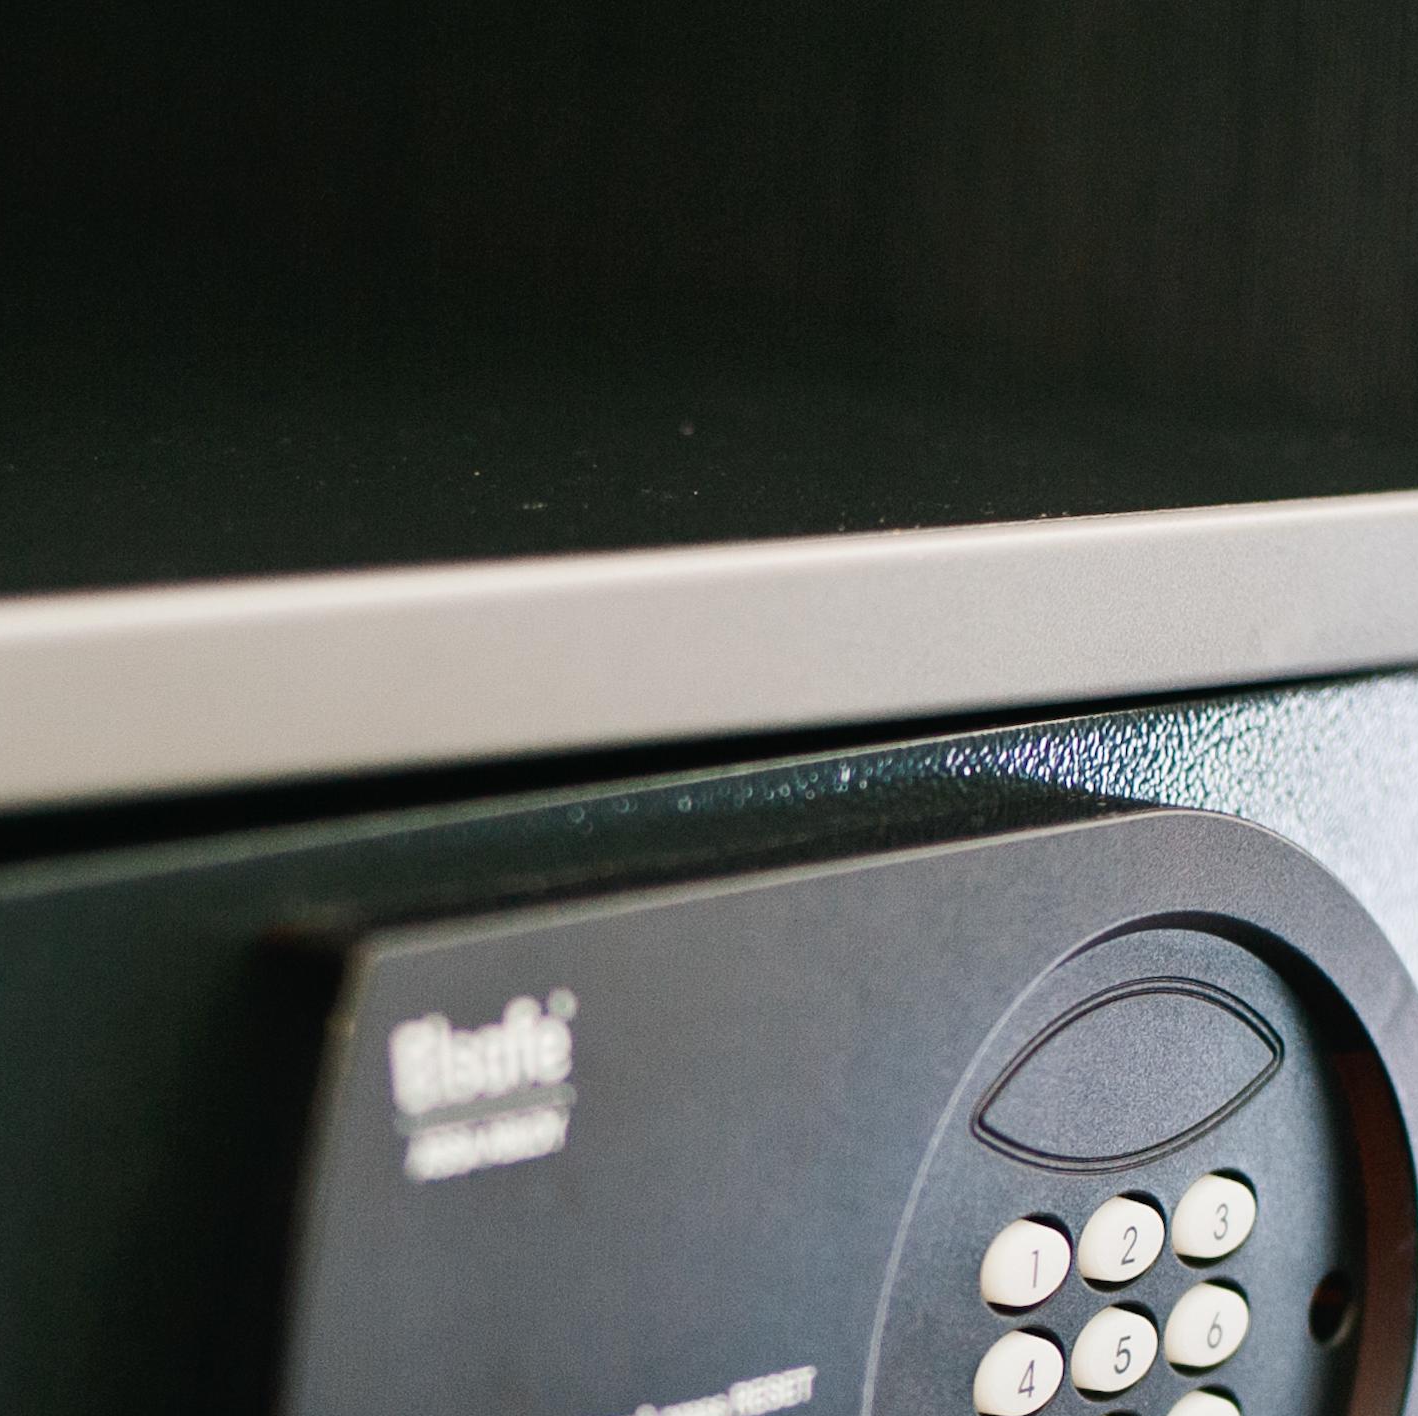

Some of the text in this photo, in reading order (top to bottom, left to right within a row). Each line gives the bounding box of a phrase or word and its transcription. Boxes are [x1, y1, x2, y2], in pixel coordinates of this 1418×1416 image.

[1212, 1202, 1230, 1241] 3
[1119, 1225, 1139, 1266] 2
[1031, 1249, 1040, 1289] 1
[1206, 1311, 1223, 1350] 6
[1112, 1335, 1132, 1375] 5
[1017, 1358, 1036, 1399] 4
